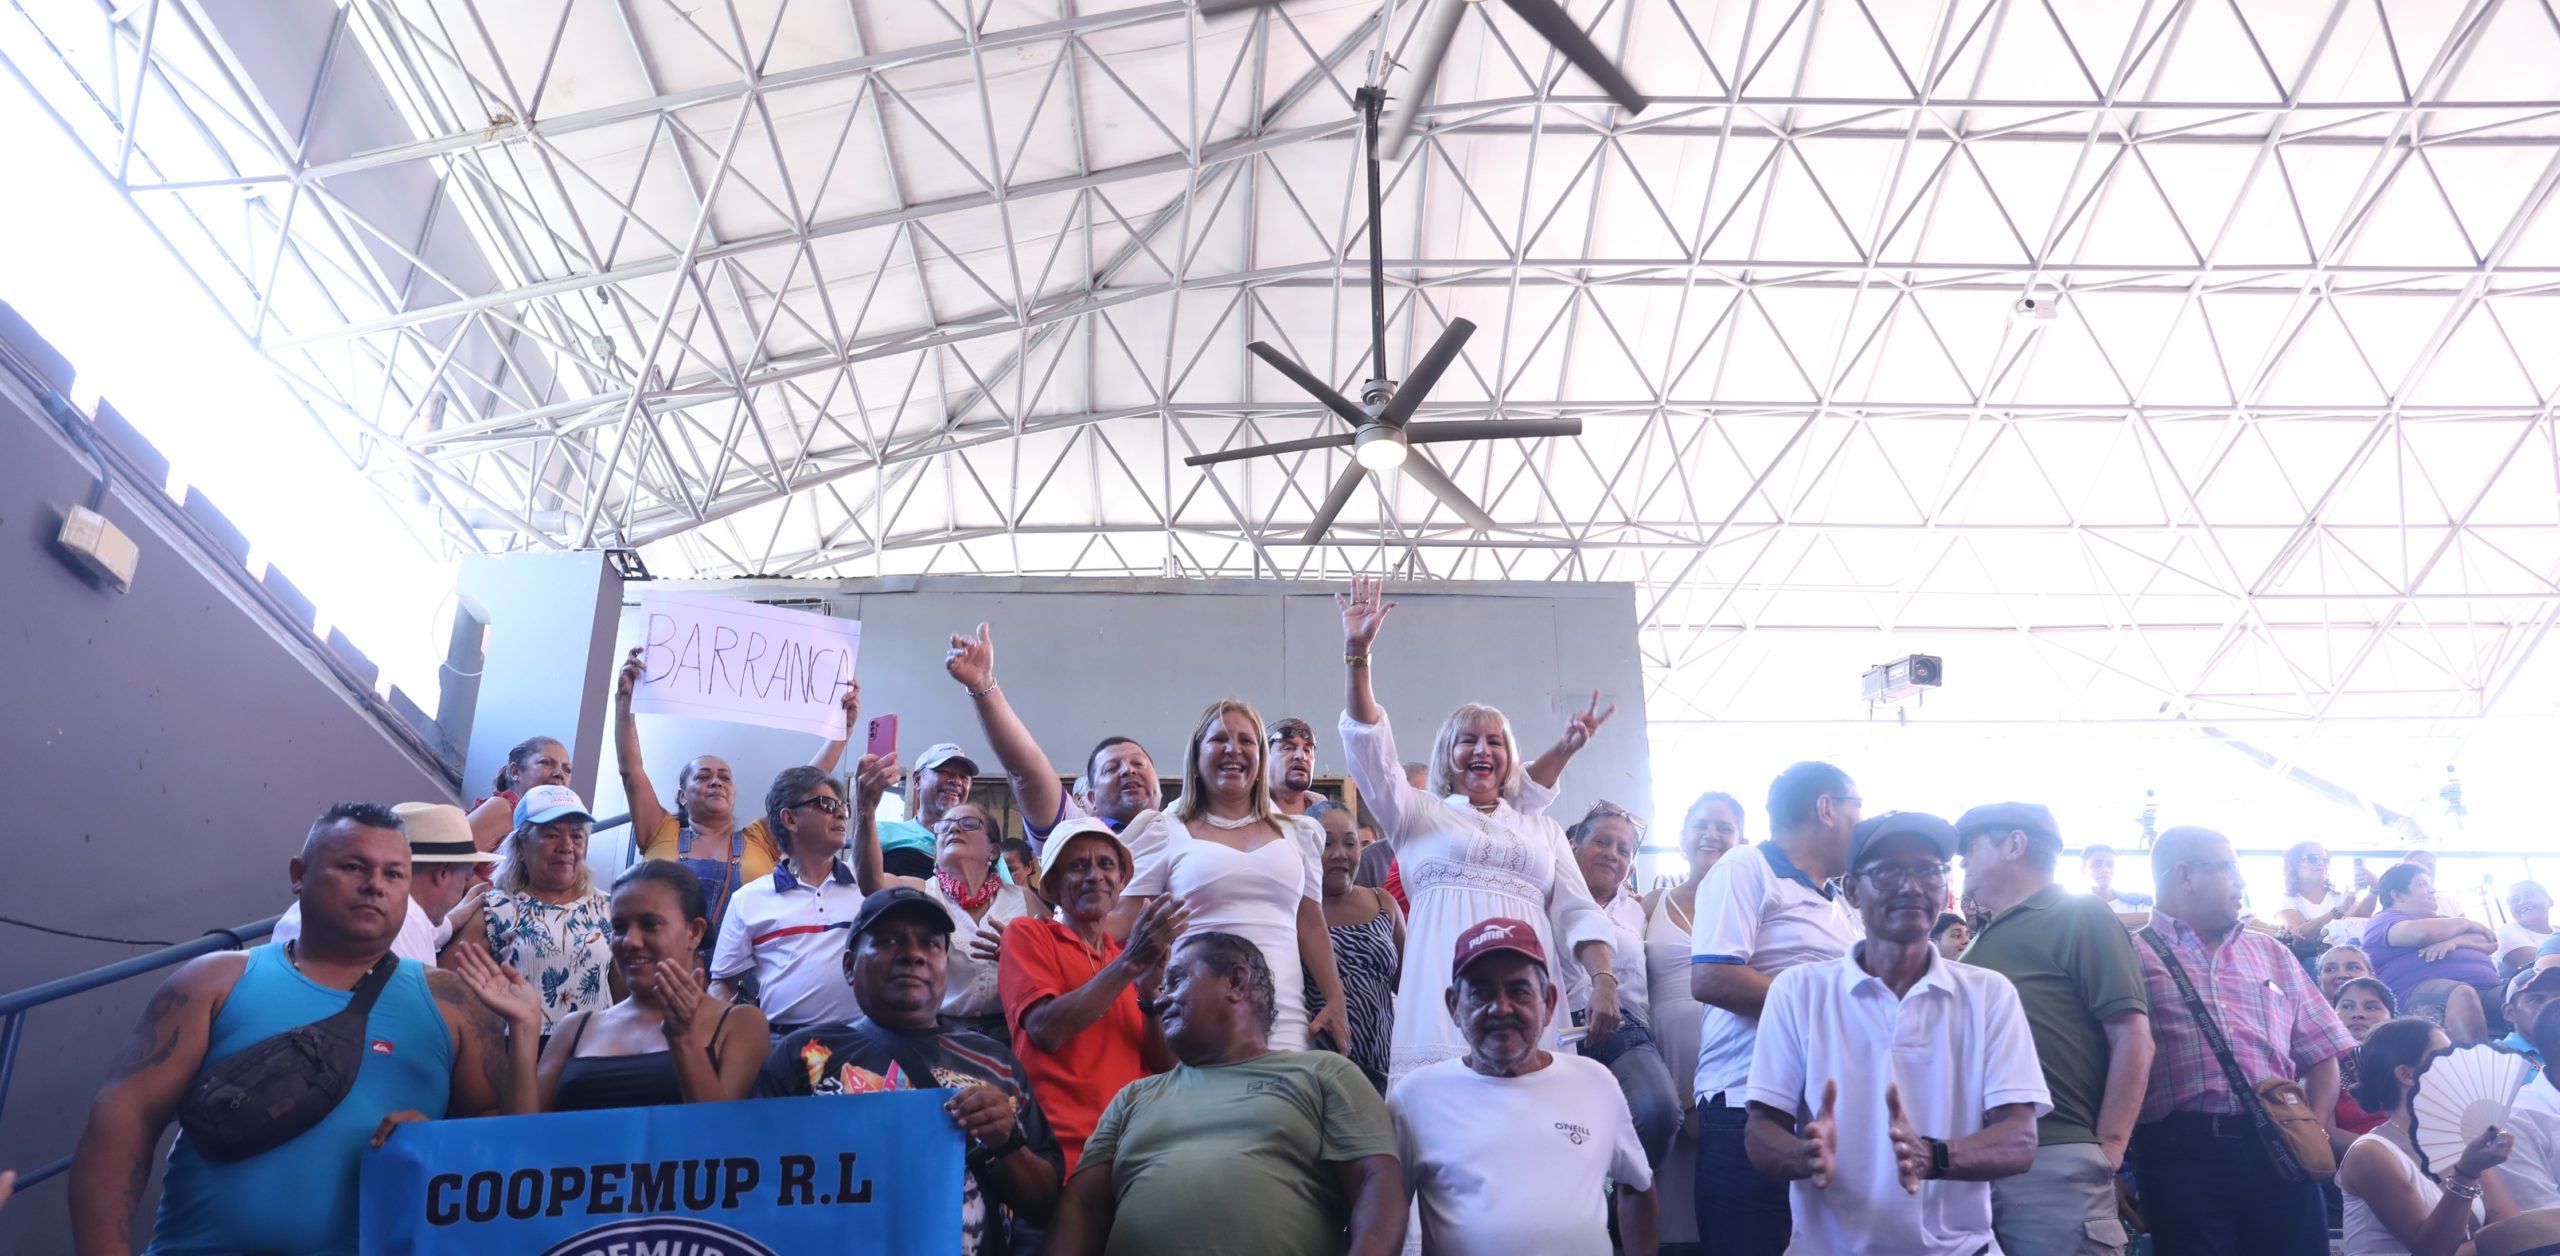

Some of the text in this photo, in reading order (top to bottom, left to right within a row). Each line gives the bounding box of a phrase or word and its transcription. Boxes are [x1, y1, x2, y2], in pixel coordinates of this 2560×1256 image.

[643, 613, 852, 705] BARRANCA
[1468, 930, 1505, 950] PUMA
[425, 1151, 873, 1227] COOPEMUP R.L
